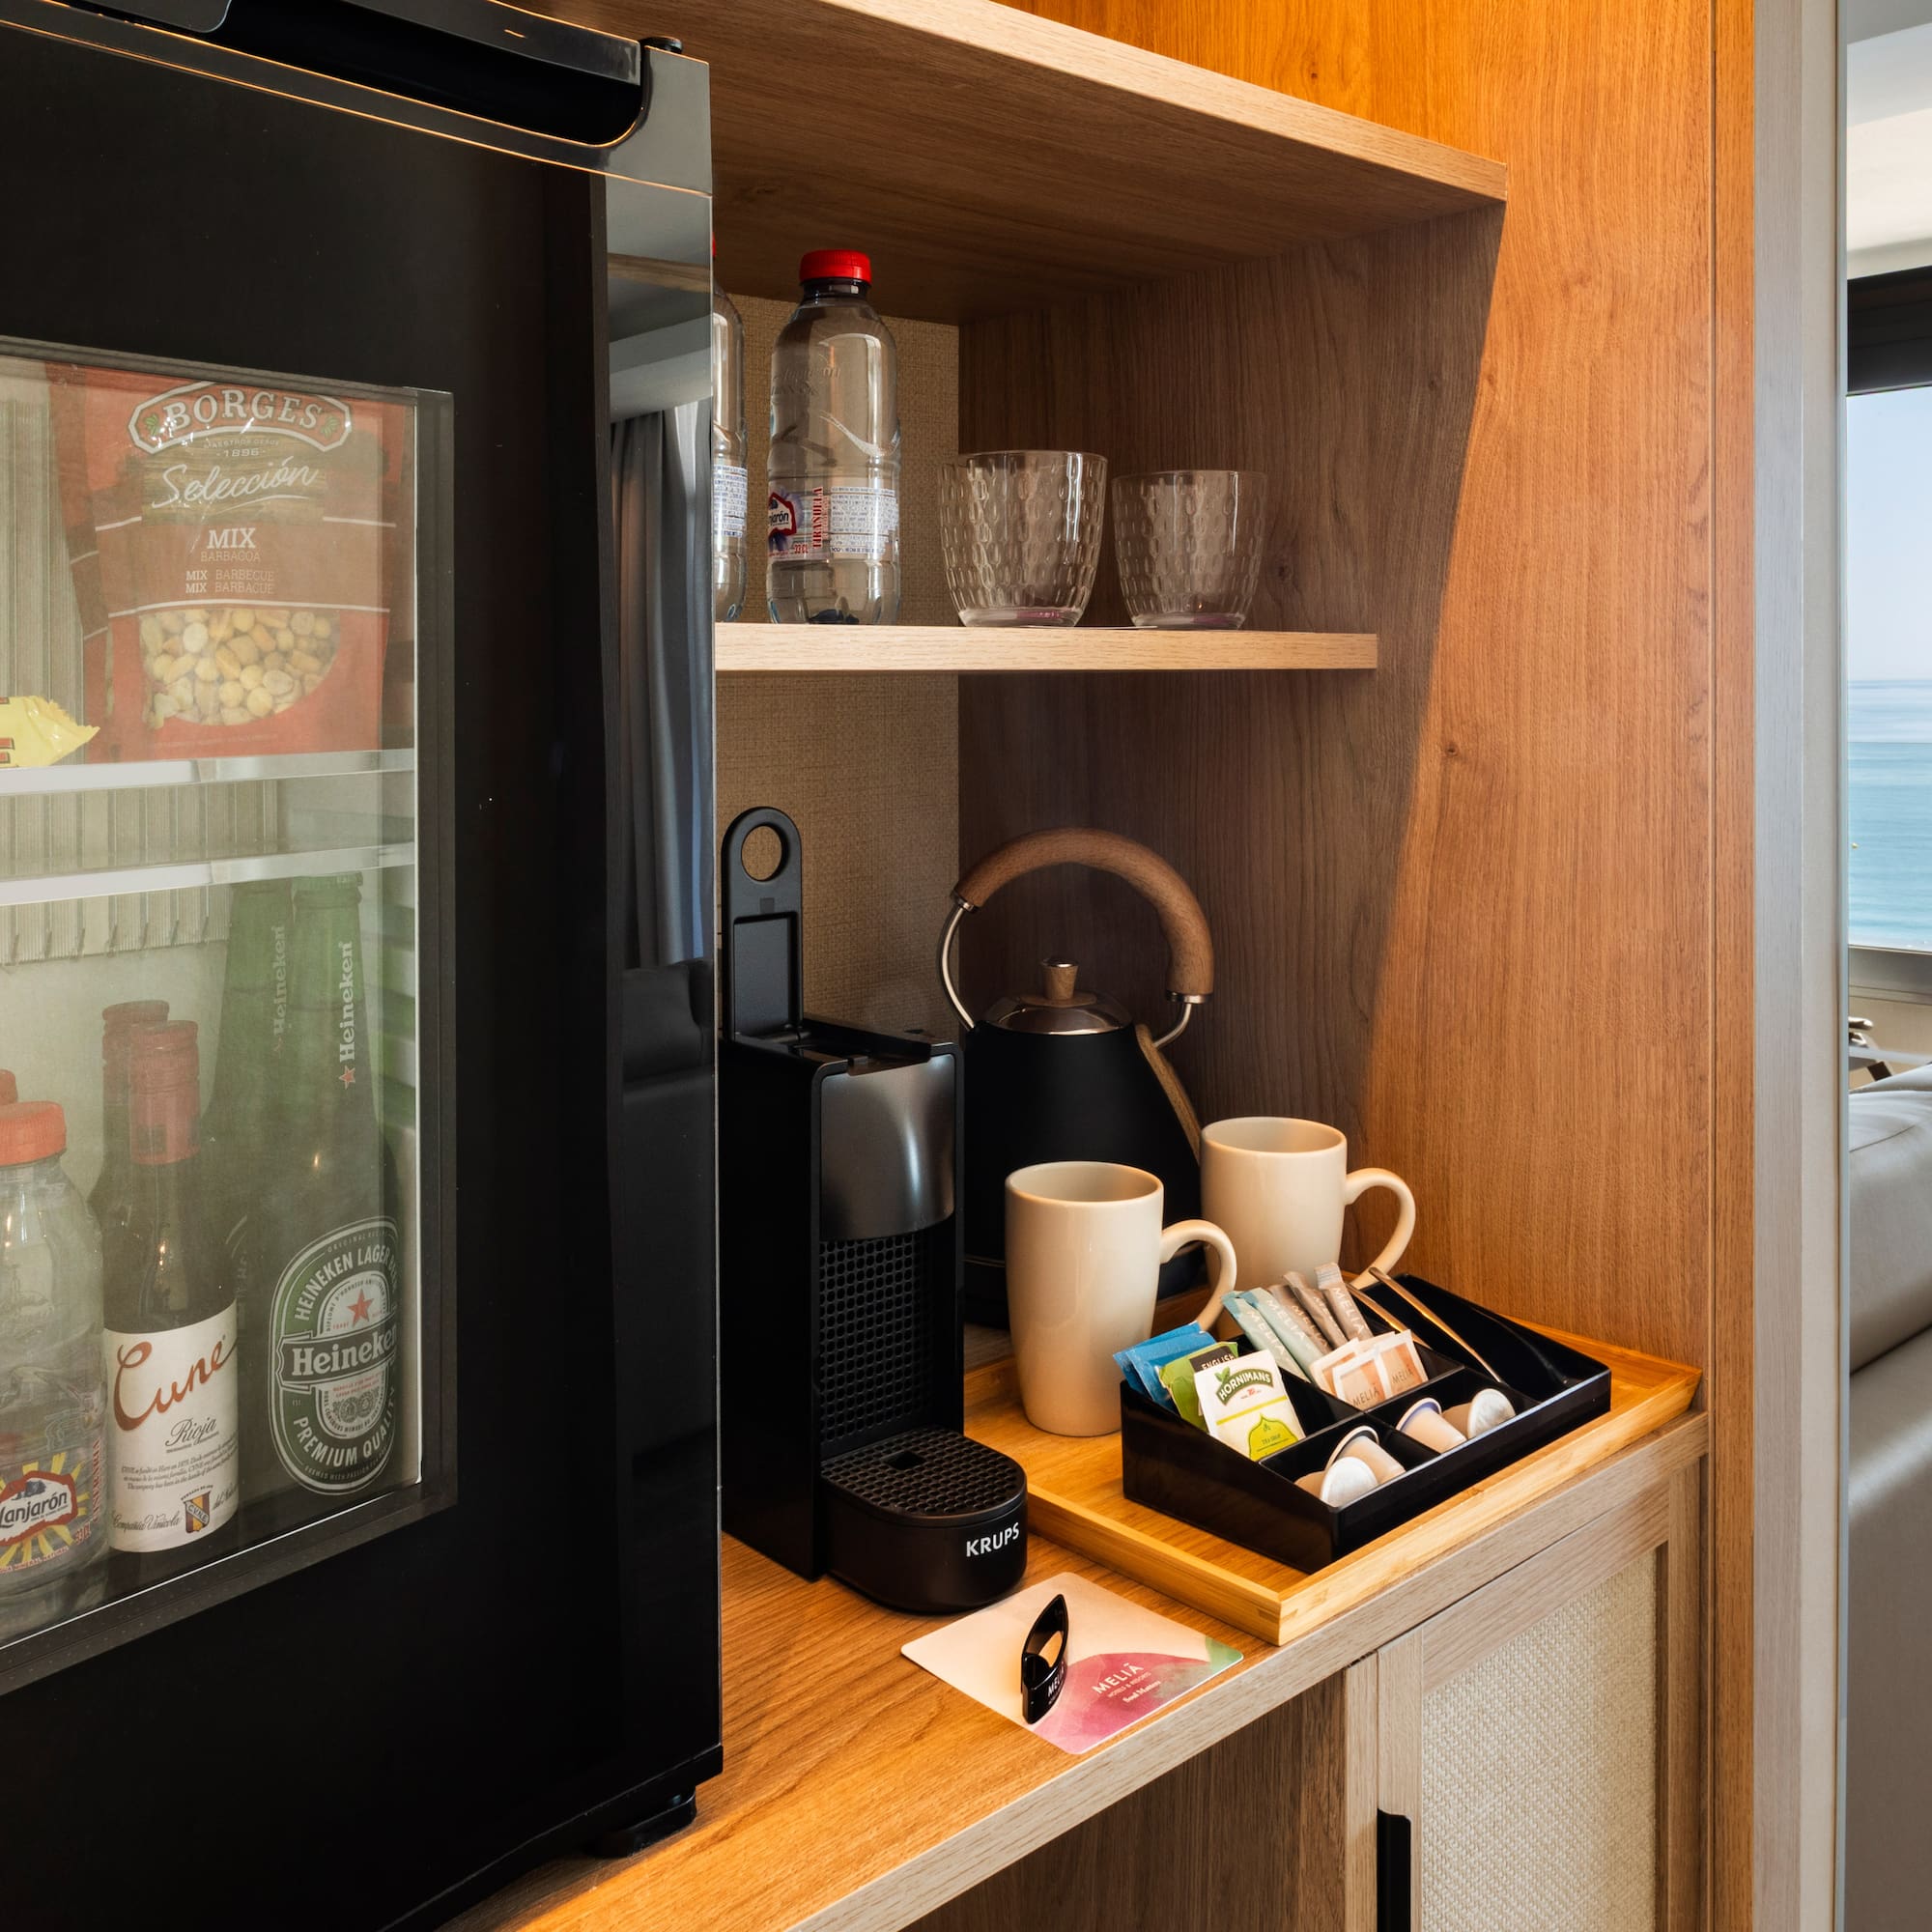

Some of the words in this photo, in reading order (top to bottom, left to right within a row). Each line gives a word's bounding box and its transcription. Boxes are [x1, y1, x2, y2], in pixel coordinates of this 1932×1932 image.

[162, 388, 324, 432] BORGES
[152, 456, 319, 508] Selección
[769, 510, 789, 526] jarón
[208, 527, 257, 550] MIX
[200, 551, 262, 562] BARBACOA
[185, 570, 209, 581] MIX
[215, 568, 275, 582] BARBECUE
[185, 582, 208, 594] MIX
[270, 925, 288, 1036] Heineken
[338, 941, 355, 1063] Heineken
[294, 1252, 354, 1321] HEINEKEN
[357, 1243, 390, 1265] LAGER
[292, 1324, 397, 1377] Heineken
[1201, 1353, 1236, 1370] ENGLISH
[113, 1339, 238, 1432] Cune
[1218, 1372, 1271, 1401] HORNIMANS
[165, 1417, 217, 1447] Rioja
[294, 1416, 357, 1467] PREMIUM
[362, 1387, 395, 1458] QUALITY
[0, 1492, 68, 1528] Lanjarón
[187, 1504, 209, 1523] CVNE
[966, 1522, 1020, 1557] KRUPS
